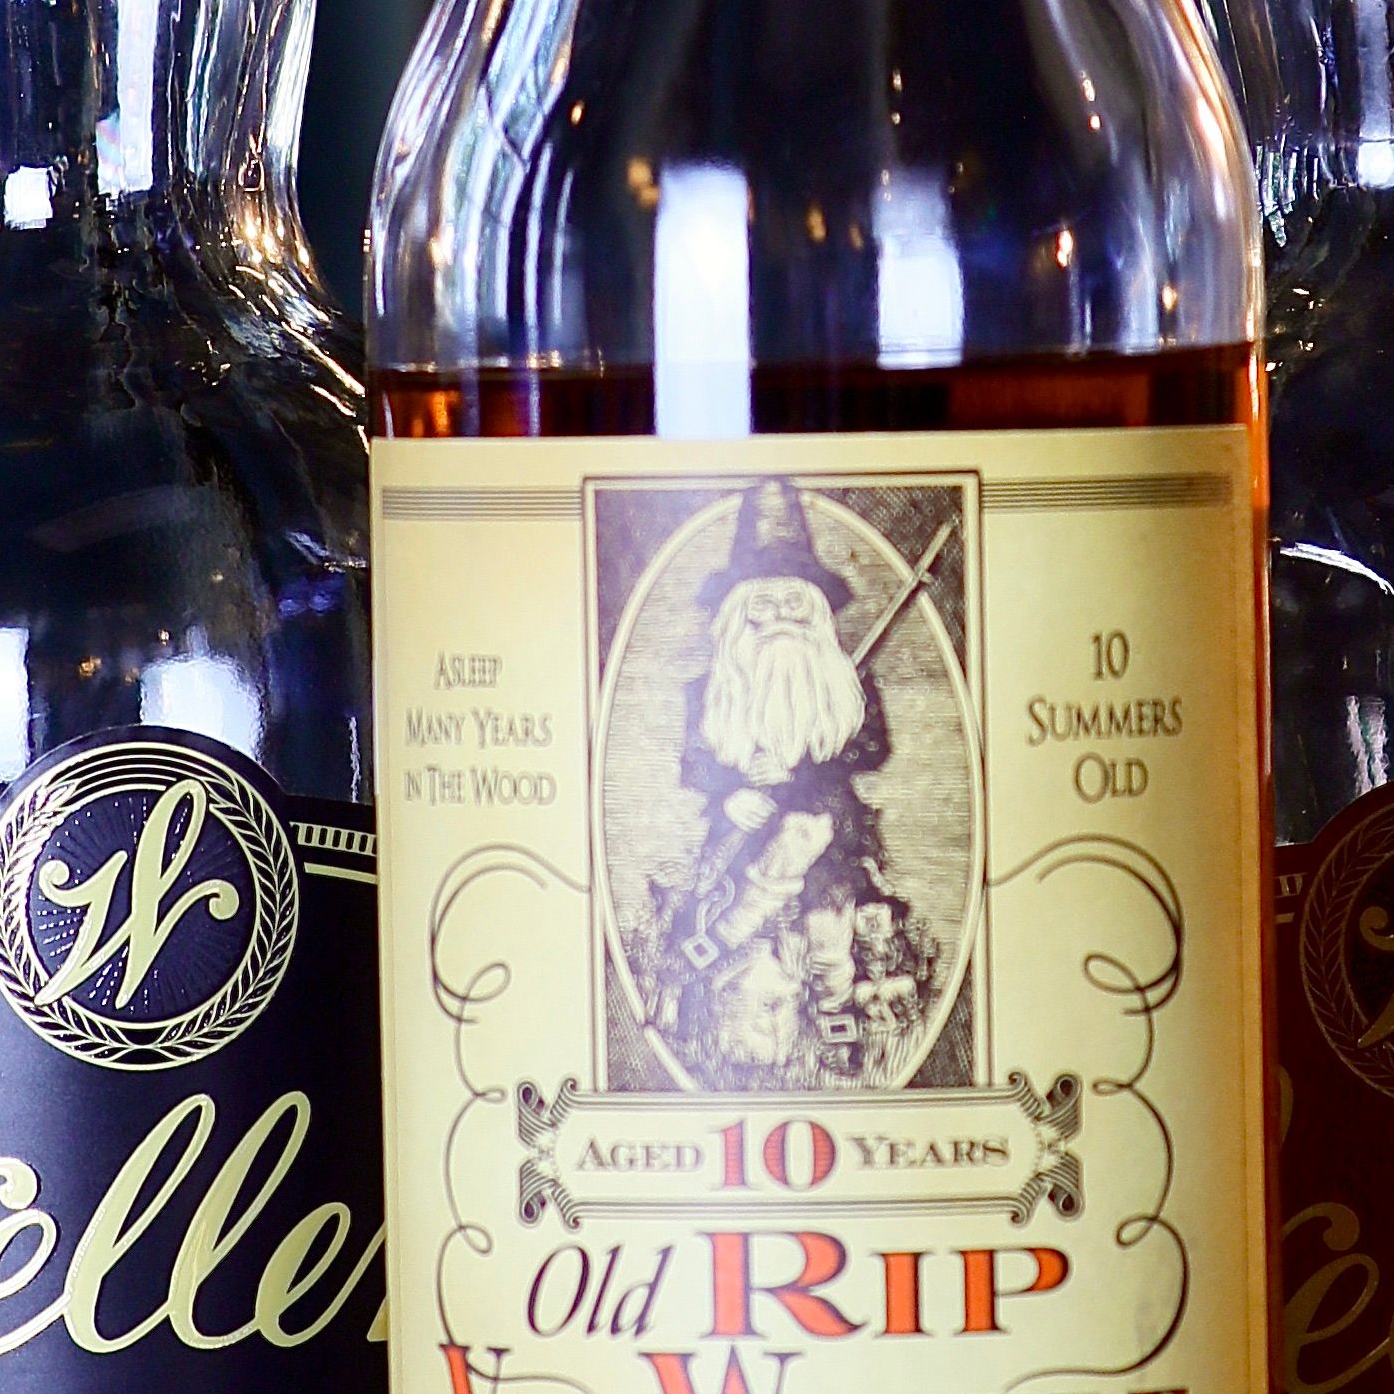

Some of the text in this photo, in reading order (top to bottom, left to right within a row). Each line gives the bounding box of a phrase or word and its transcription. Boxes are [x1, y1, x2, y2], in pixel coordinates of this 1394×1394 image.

[1092, 629, 1130, 680] 10
[711, 1119, 837, 1189] 10
[525, 1244, 676, 1338] Old
